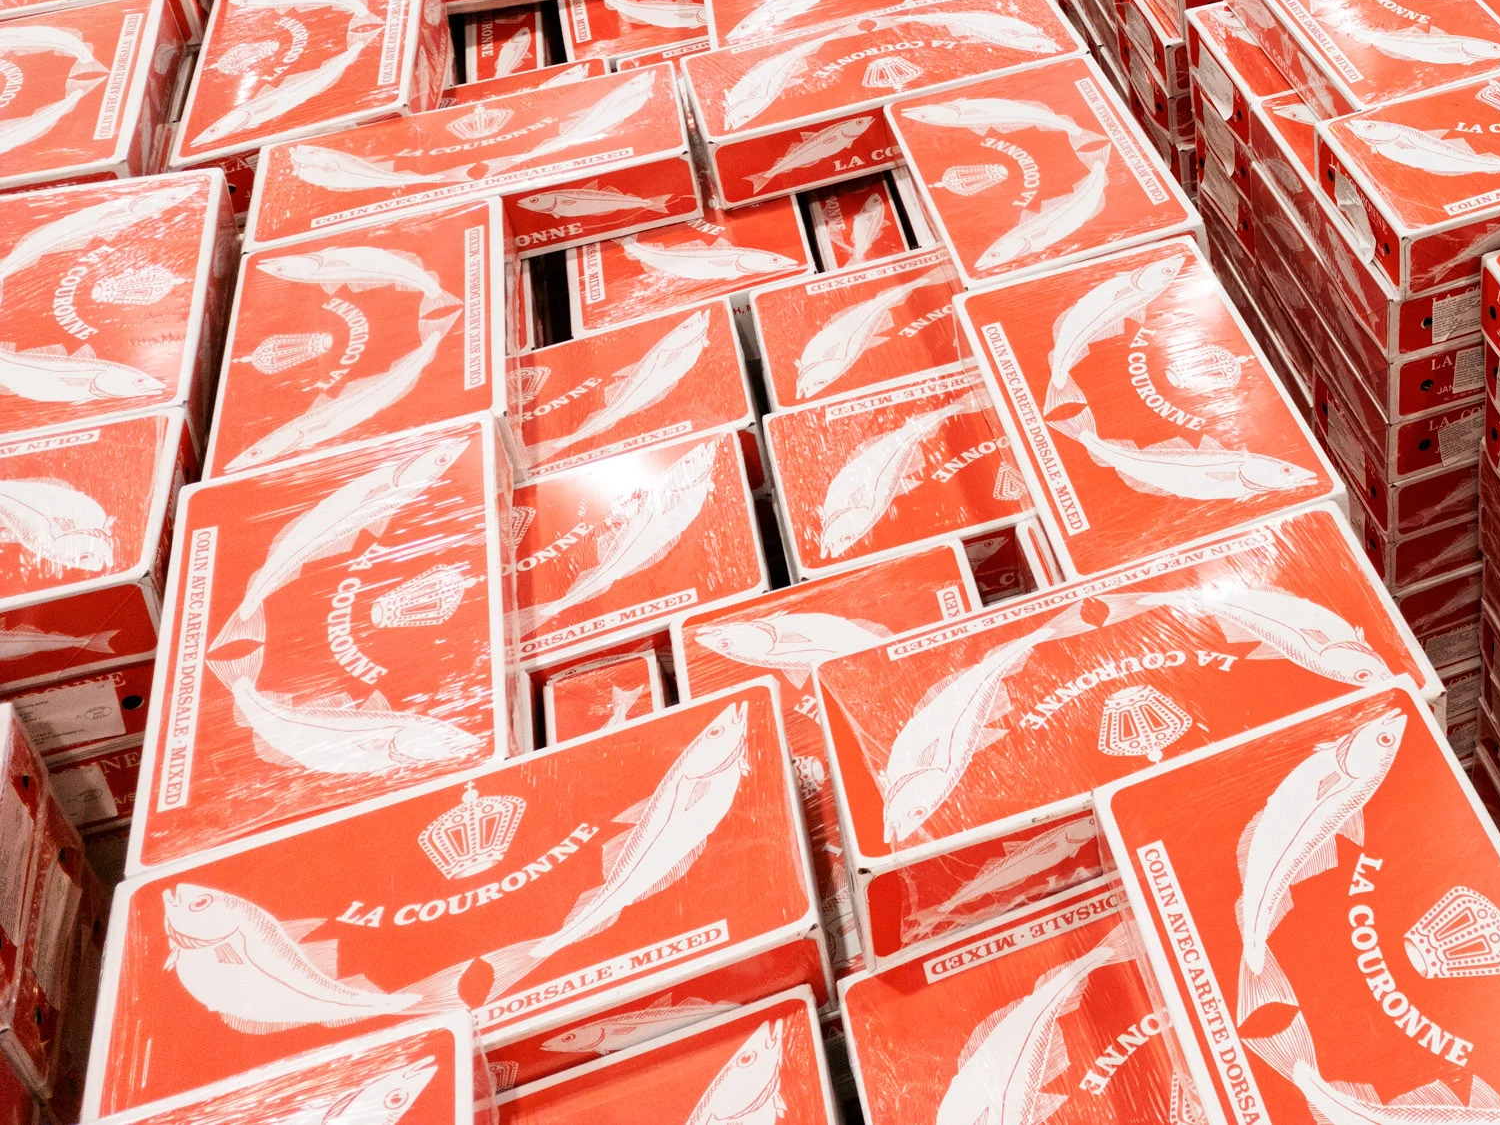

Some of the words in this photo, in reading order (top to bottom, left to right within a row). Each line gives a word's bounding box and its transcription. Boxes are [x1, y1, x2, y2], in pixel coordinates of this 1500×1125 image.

[815, 41, 926, 79] COURONNE
[935, 40, 957, 50] LA
[1333, 53, 1360, 81] MIXED
[397, 145, 428, 159] LA
[430, 116, 558, 158] COURONNE
[1455, 121, 1484, 135] LA
[981, 137, 1041, 189] COURONNE
[315, 208, 370, 225] COLIN
[374, 195, 418, 209] AVEC
[570, 149, 630, 169] MIXED
[1013, 189, 1033, 209] LA
[1448, 199, 1492, 215] COLIN
[80, 245, 114, 271] LA
[470, 228, 480, 258] MIXED
[470, 261, 480, 301] DORSALE
[808, 271, 870, 294] MIXED
[55, 269, 98, 341] COURONNE
[321, 298, 369, 365] COURONNE
[1128, 327, 1156, 359] LA
[830, 393, 893, 418] MIXED
[1128, 359, 1205, 431] COURONNE
[622, 423, 689, 446] MIXED
[986, 325, 1008, 359] COLIN
[1000, 357, 1021, 386] AVEC
[1029, 427, 1062, 481] DORSALE
[1055, 484, 1084, 531] MIXED
[194, 531, 211, 571] COLIN
[347, 542, 390, 571] LA
[190, 575, 206, 609] AVEC
[618, 591, 694, 625] MIXED
[982, 589, 1078, 630] DORSALE
[328, 576, 389, 685] COURONNE
[892, 623, 970, 657] MIXED
[1197, 649, 1238, 673] LA
[174, 664, 196, 738] DORSALE
[1018, 649, 1186, 731] COURONNE
[165, 746, 187, 807] MIXED
[336, 901, 381, 928] LA
[393, 821, 600, 927] COURONNE
[1348, 851, 1384, 897] LA
[1144, 849, 1178, 907] COLIN
[1167, 910, 1203, 963] AVEC
[486, 963, 612, 1023] DORSALE
[630, 925, 723, 969] MIXED
[930, 935, 1018, 978] MIXED
[1348, 905, 1474, 1069] COURONNE
